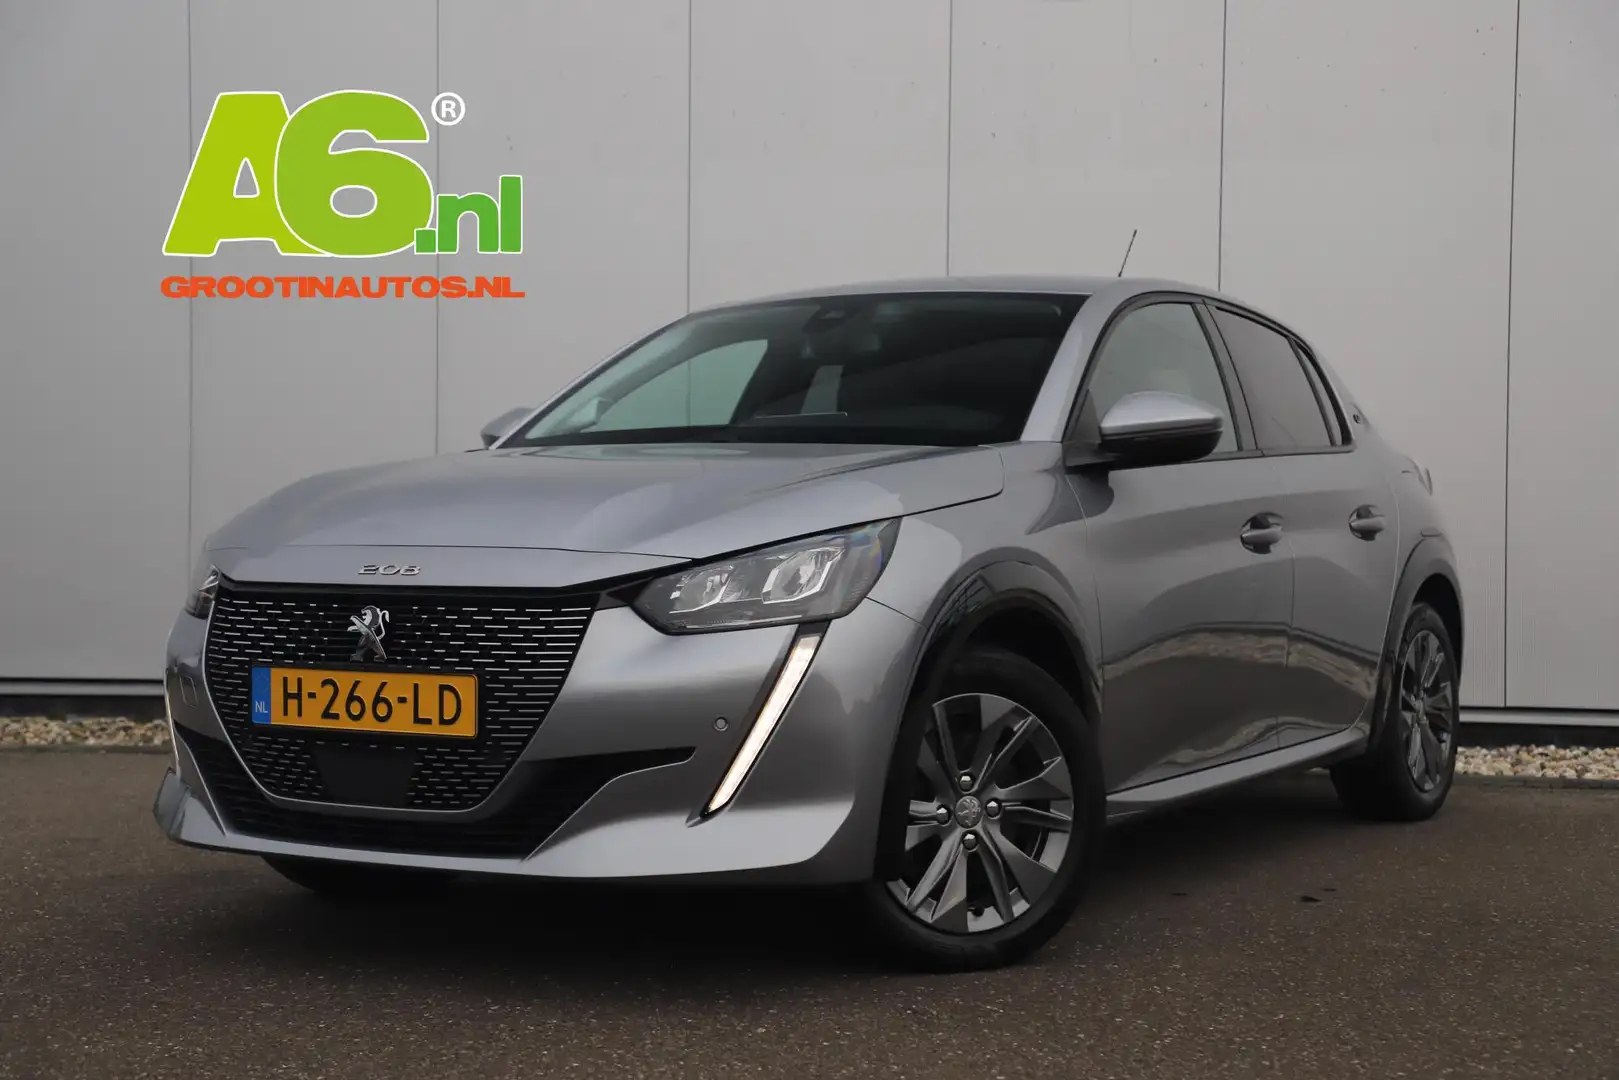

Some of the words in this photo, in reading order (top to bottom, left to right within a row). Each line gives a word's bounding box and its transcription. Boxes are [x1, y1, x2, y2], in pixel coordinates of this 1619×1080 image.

[358, 564, 421, 576] 208
[255, 702, 269, 714] NL
[282, 675, 463, 726] H-266-LD
